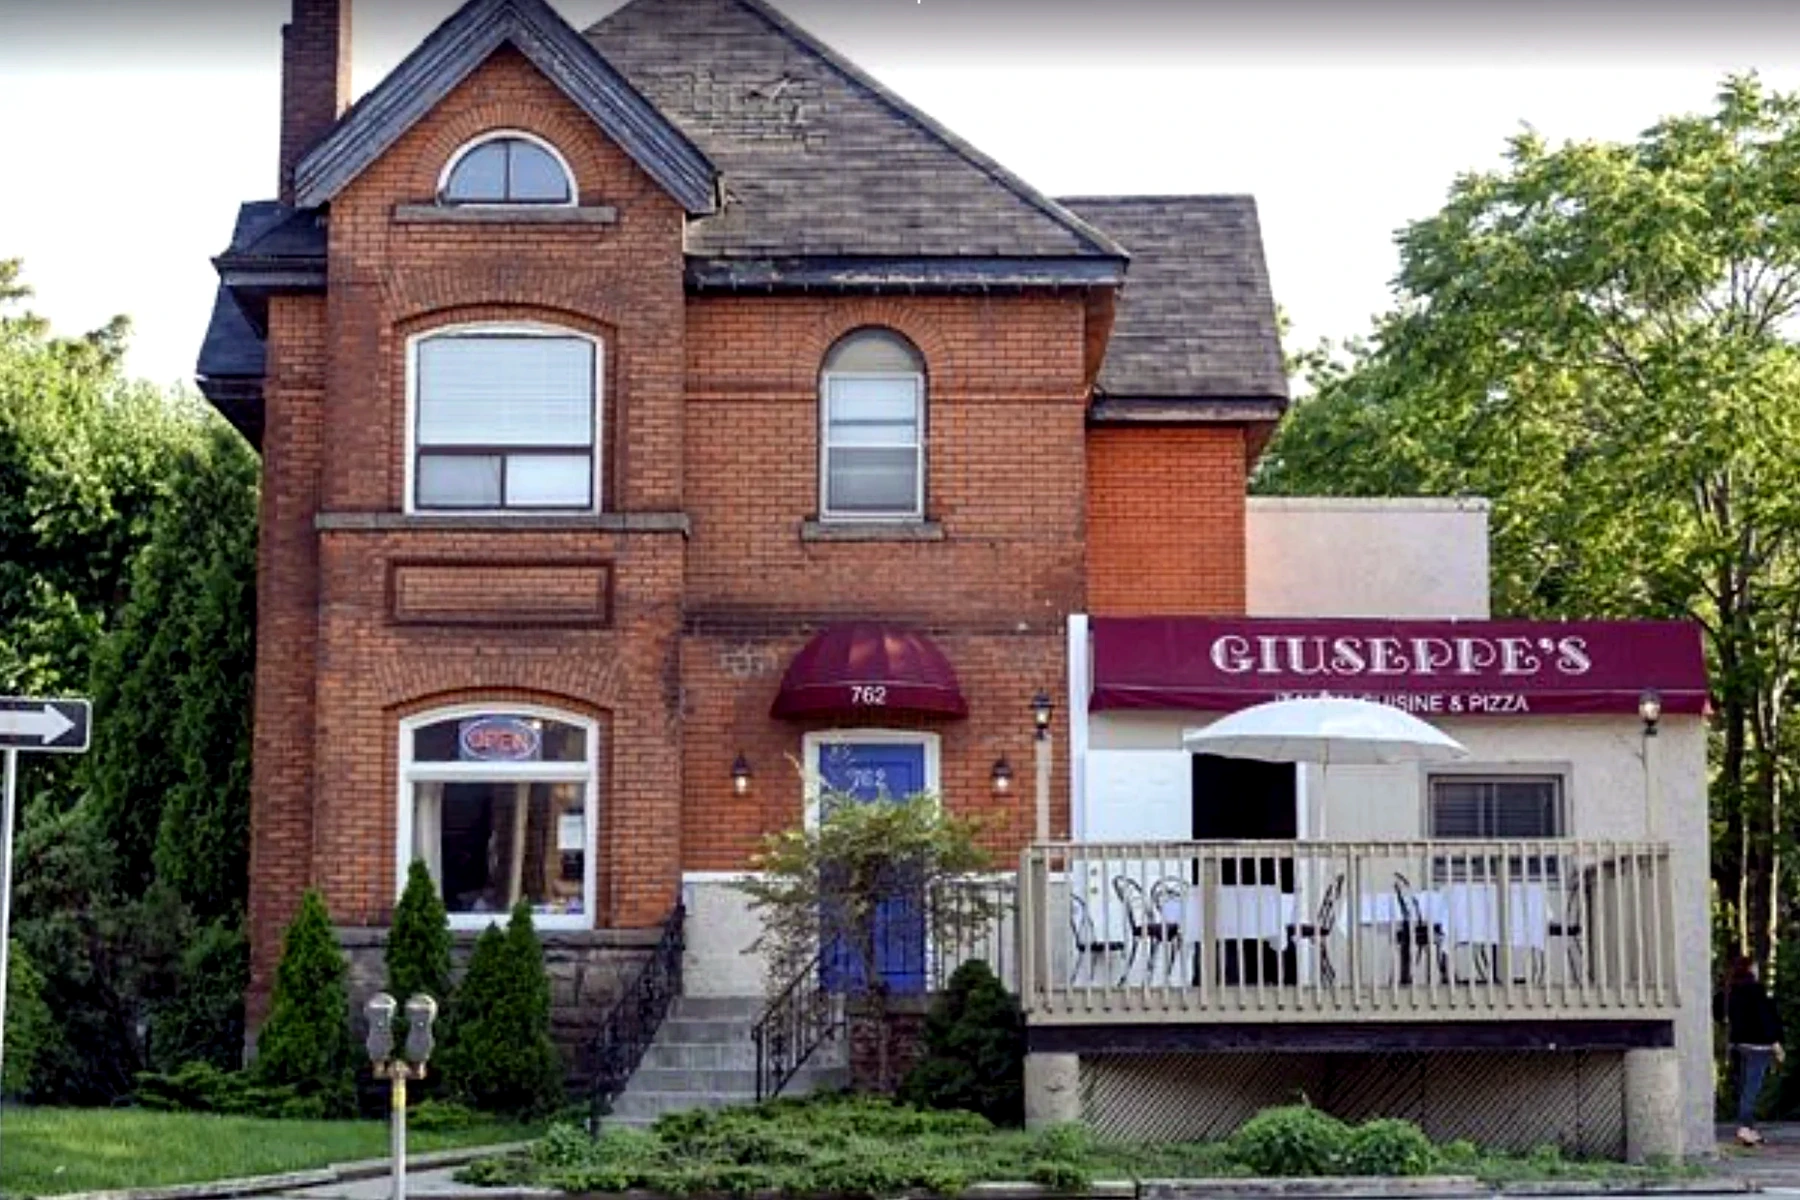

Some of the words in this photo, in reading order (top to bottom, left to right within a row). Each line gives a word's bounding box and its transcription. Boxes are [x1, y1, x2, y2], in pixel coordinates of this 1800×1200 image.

[1210, 634, 1592, 675] GIUSEPPE'S
[851, 686, 886, 705] 762
[1449, 694, 1464, 712] &
[1469, 694, 1529, 712] PIZZA
[467, 728, 530, 752] OPEN
